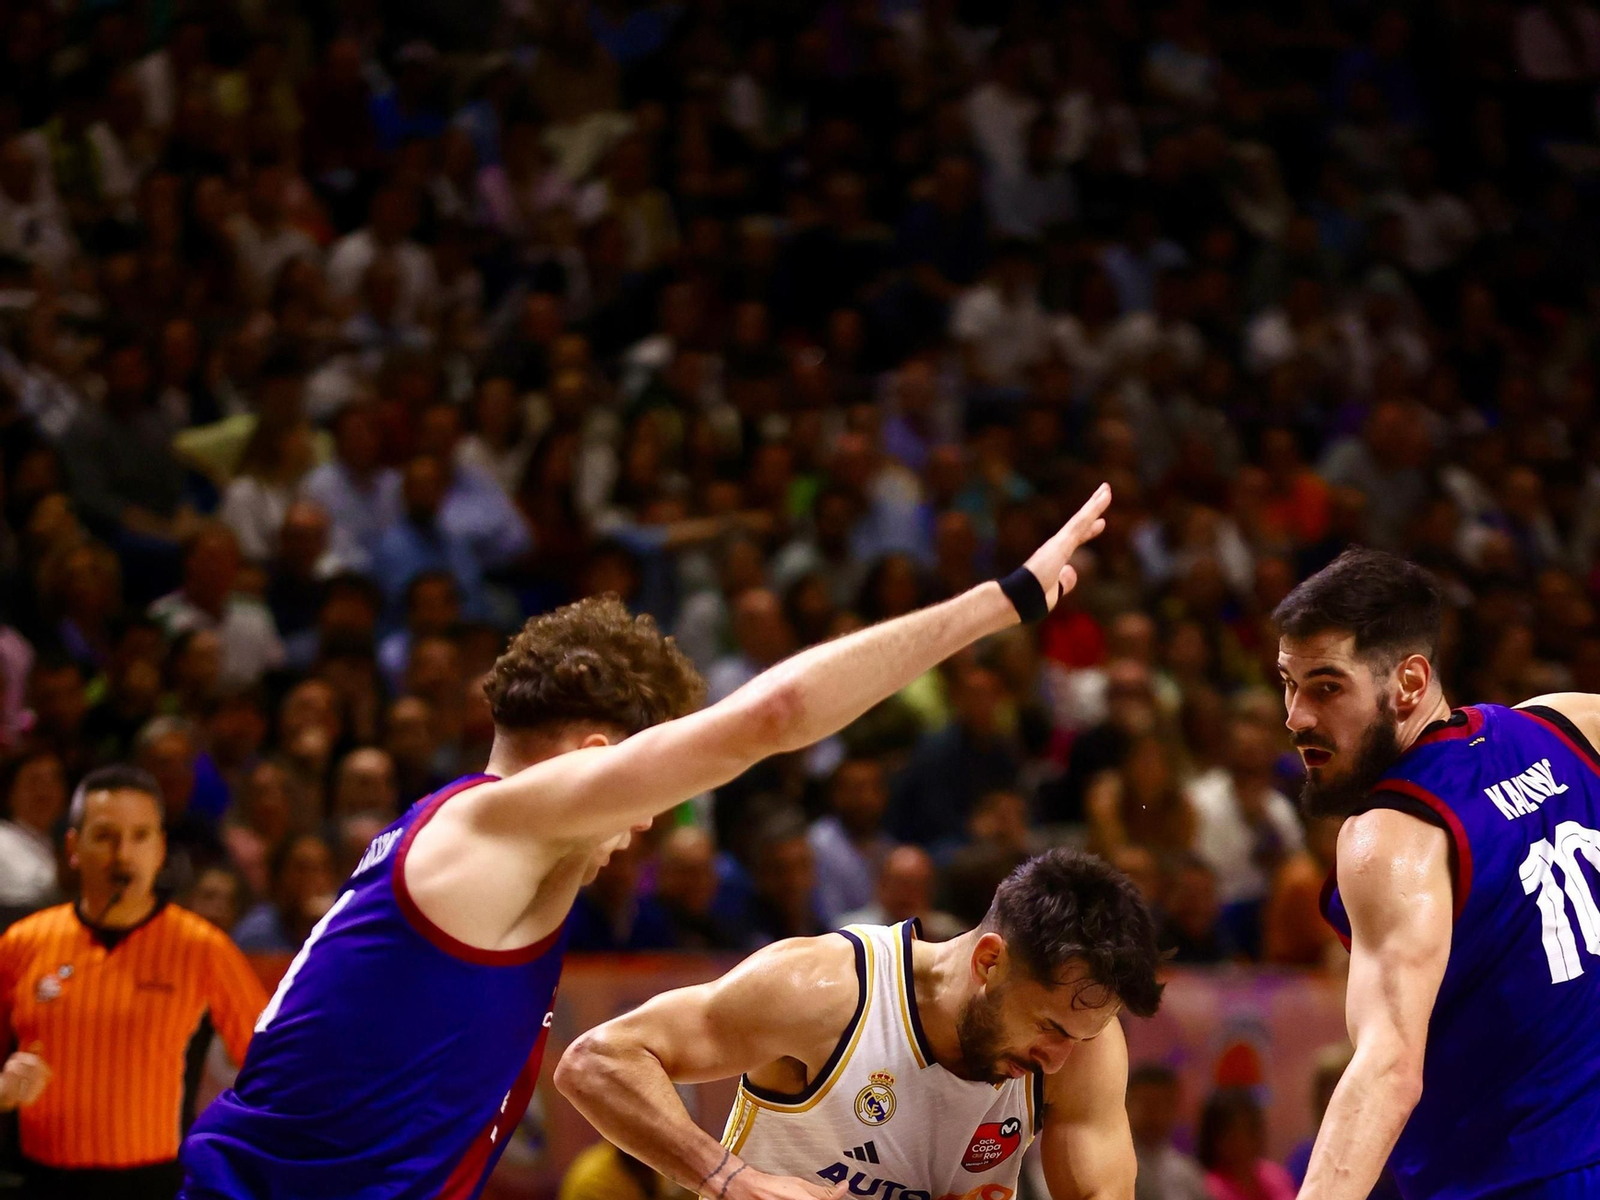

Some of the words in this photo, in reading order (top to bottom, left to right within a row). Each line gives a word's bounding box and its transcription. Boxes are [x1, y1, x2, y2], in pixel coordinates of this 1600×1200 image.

[1518, 820, 1600, 984] 10
[971, 1143, 1002, 1153] Copa
[983, 1151, 1003, 1160] Rey
